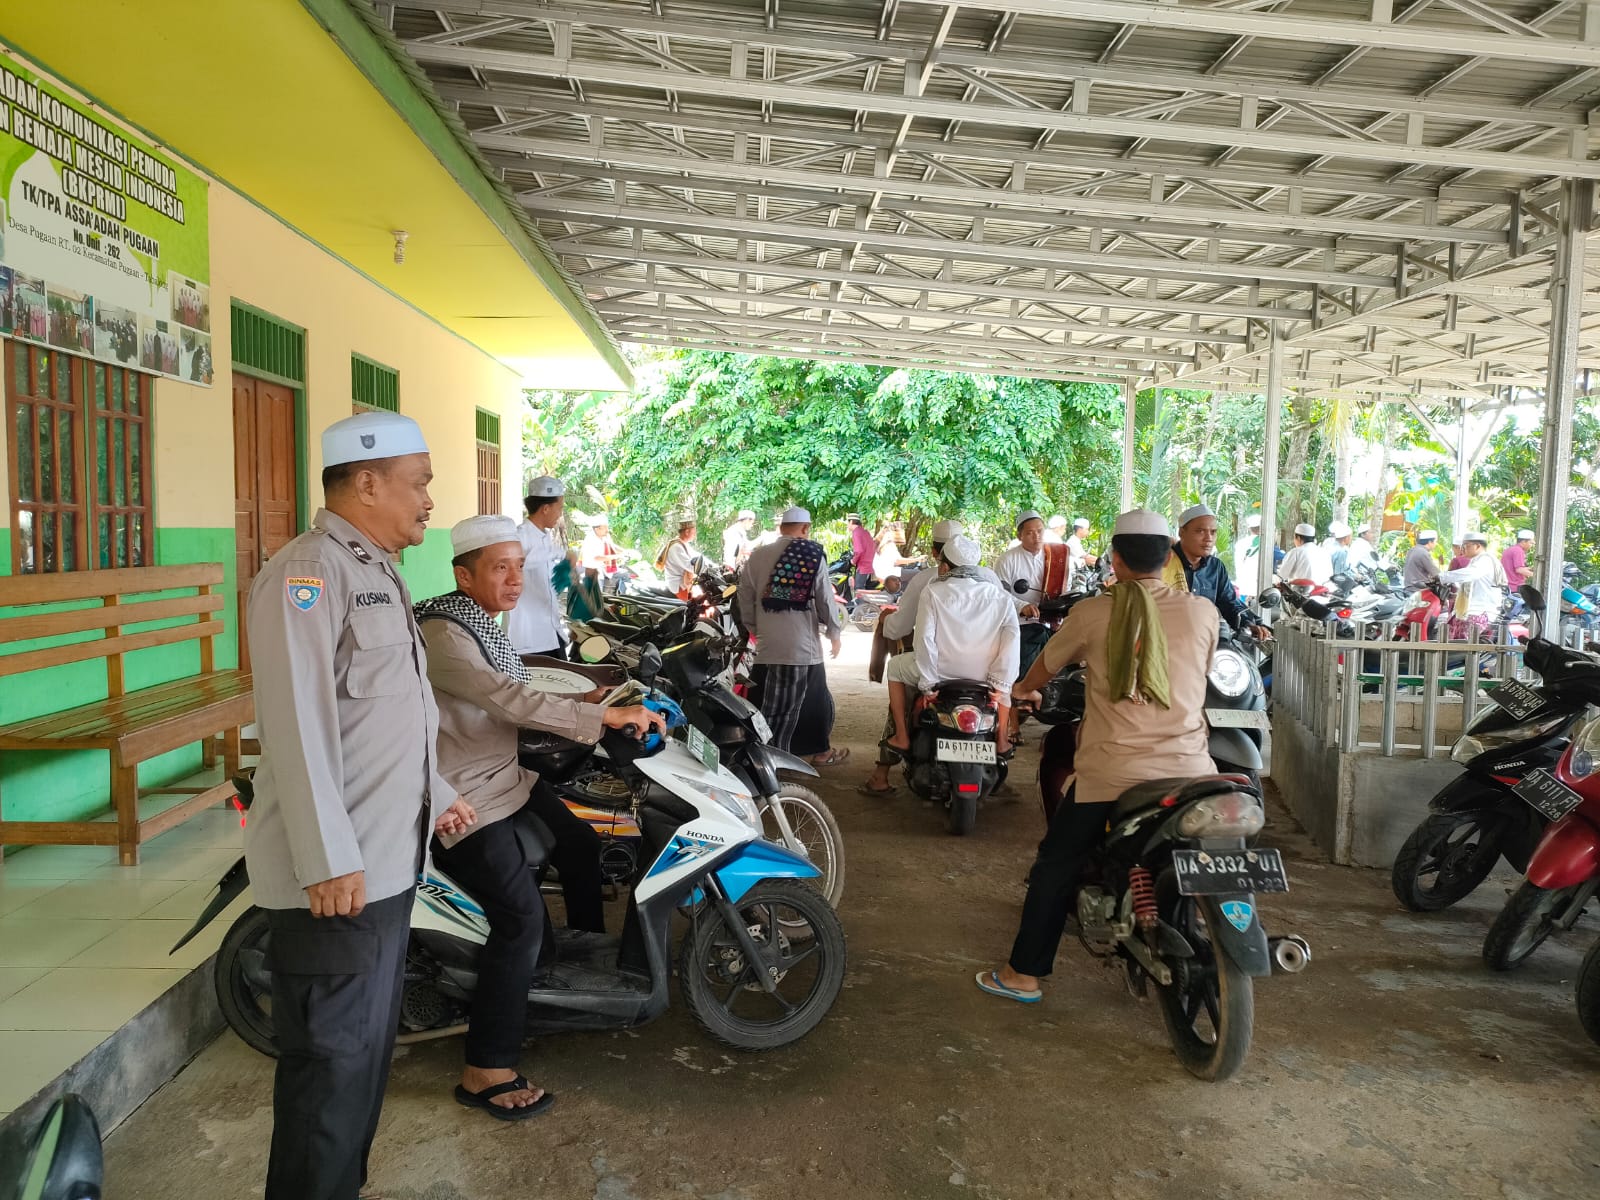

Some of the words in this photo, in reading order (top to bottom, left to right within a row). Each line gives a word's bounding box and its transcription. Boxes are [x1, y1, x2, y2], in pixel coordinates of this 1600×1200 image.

[41, 89, 129, 167] KOMUNIKASI
[129, 143, 177, 195] PEMUDA
[12, 106, 73, 165] REMAJA
[75, 140, 123, 192] MESJID
[125, 169, 185, 225] INDONESIA
[62, 165, 126, 222] (BKPRMI)
[9, 216, 28, 234] Desa
[30, 225, 57, 246] Pugaan
[22, 180, 62, 215] TK/TPA
[65, 200, 120, 241] ASSA'ADAH
[123, 227, 159, 258] PUGAAN
[288, 578, 321, 586] BINMAS
[938, 740, 950, 750] DA
[1493, 760, 1526, 771] HONDA
[1526, 770, 1543, 788] DA
[1540, 780, 1564, 800] 6111
[686, 830, 725, 843] HONDA
[1177, 856, 1200, 874] DA
